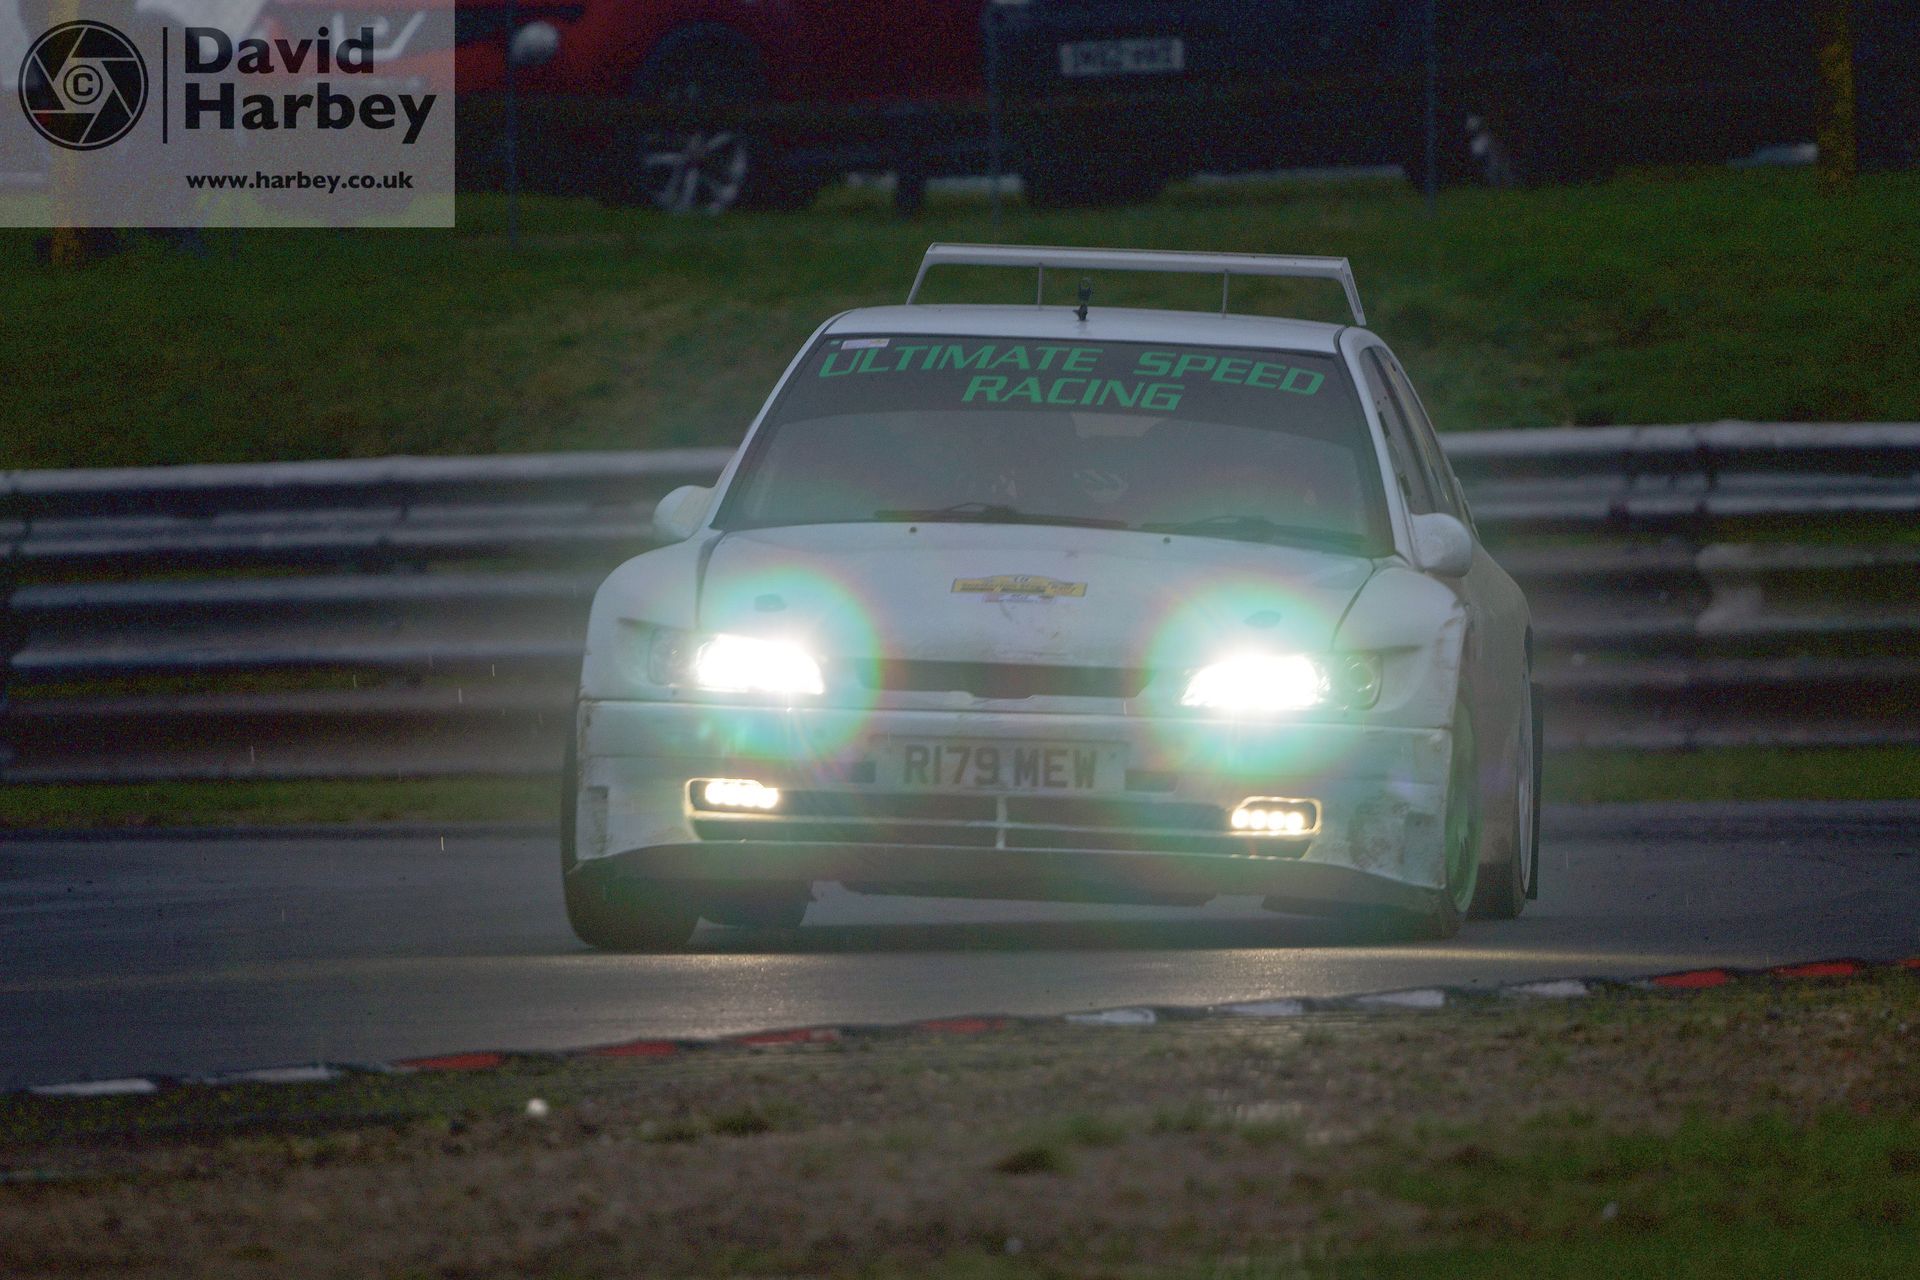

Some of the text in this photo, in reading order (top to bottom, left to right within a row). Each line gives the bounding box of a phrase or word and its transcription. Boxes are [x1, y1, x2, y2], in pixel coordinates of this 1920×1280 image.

[818, 343, 1325, 396] ULTIMATE SPEED
[961, 374, 1185, 411] RACING
[903, 744, 1098, 789] R179 MEW
